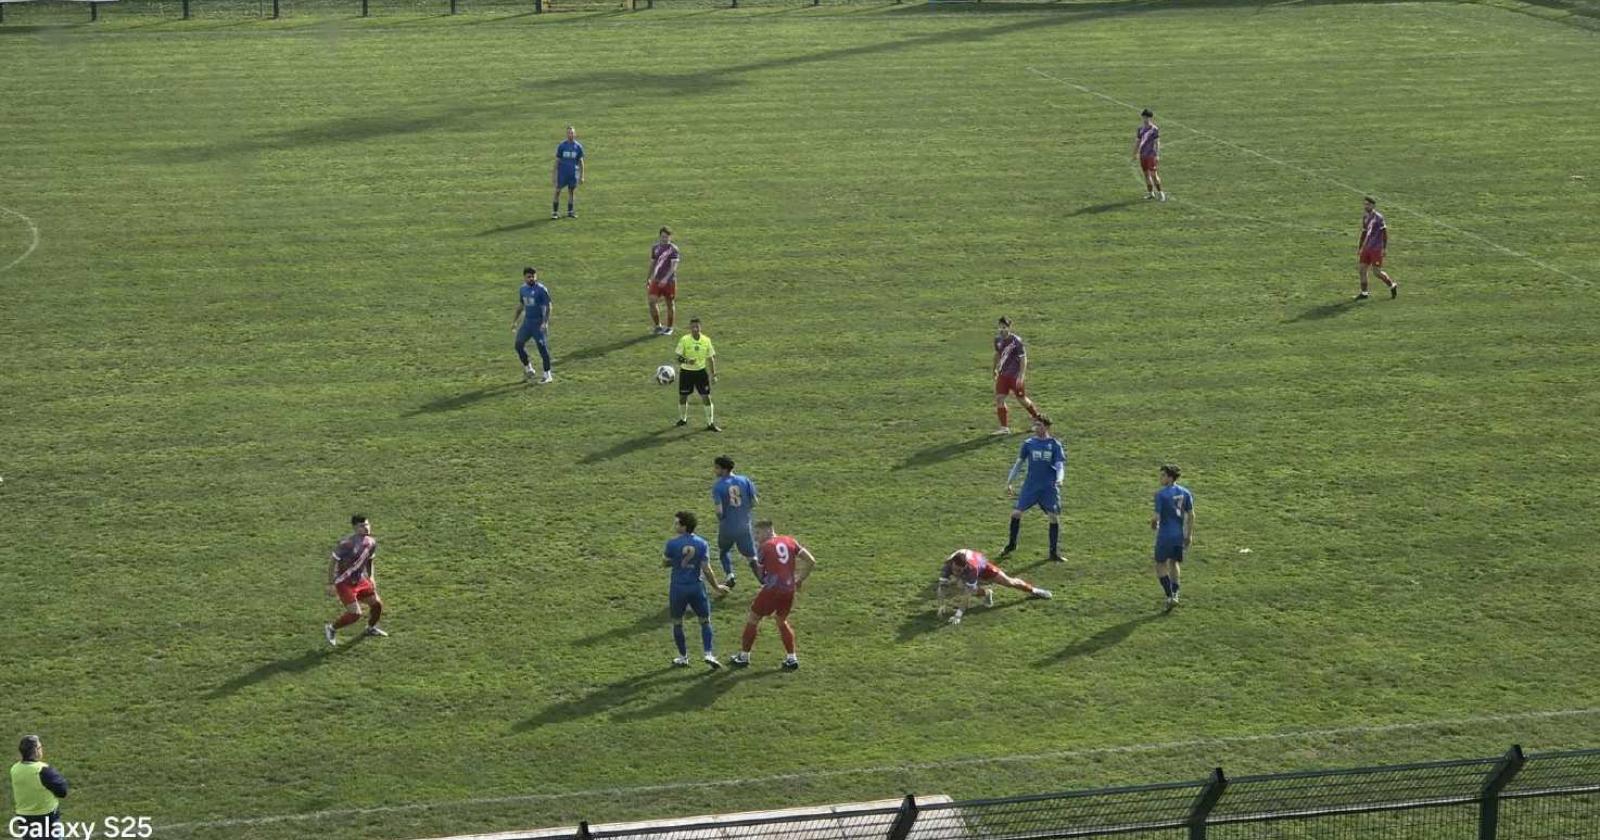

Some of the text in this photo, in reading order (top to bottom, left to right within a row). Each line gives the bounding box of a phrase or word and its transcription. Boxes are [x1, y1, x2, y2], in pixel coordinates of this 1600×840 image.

[729, 485, 742, 507] 8
[682, 545, 696, 569] 2
[776, 542, 789, 565] 9
